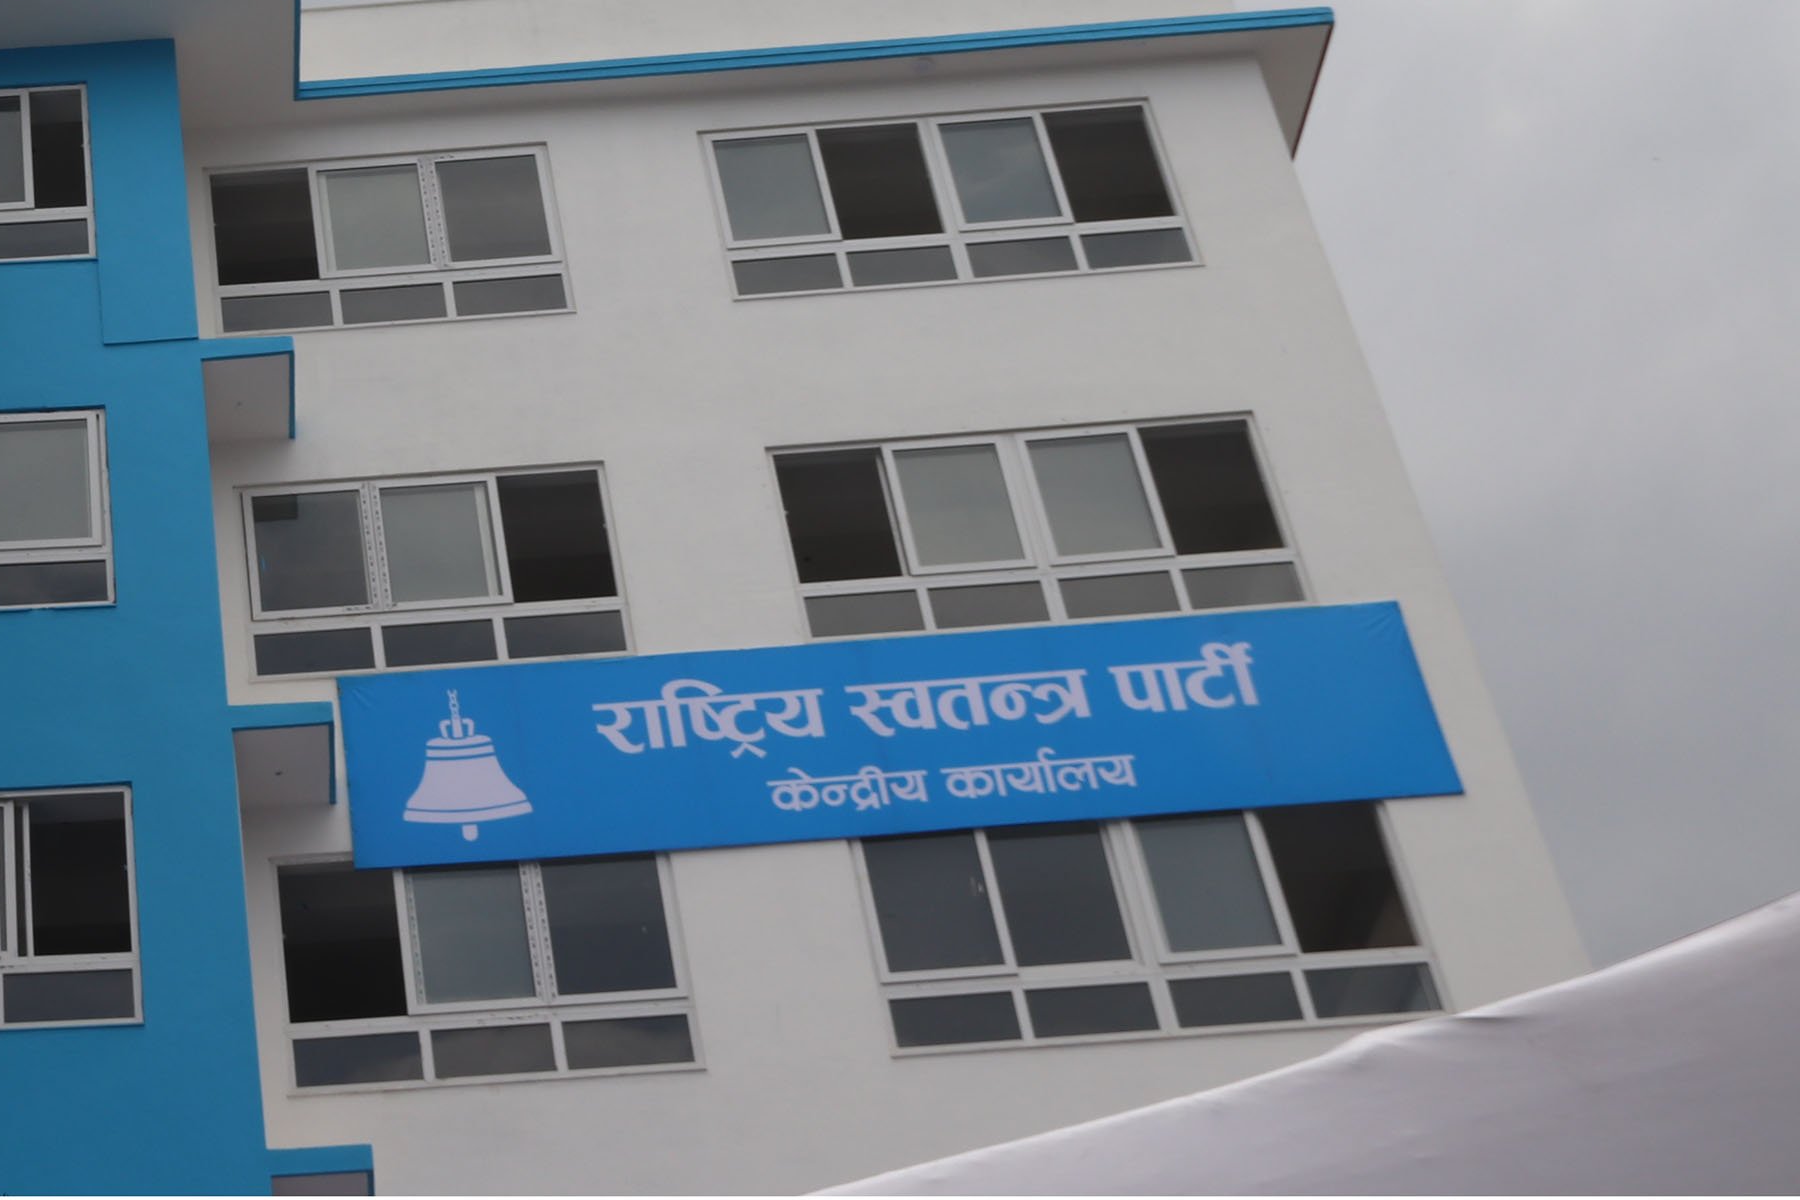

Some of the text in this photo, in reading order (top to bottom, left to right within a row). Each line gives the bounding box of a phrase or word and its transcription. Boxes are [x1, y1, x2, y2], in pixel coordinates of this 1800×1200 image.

[592, 642, 1260, 759] राष्ट्रिय स्वतन्त्र पार्टी
[767, 747, 1137, 811] केन्द्रीय कार्यालय
